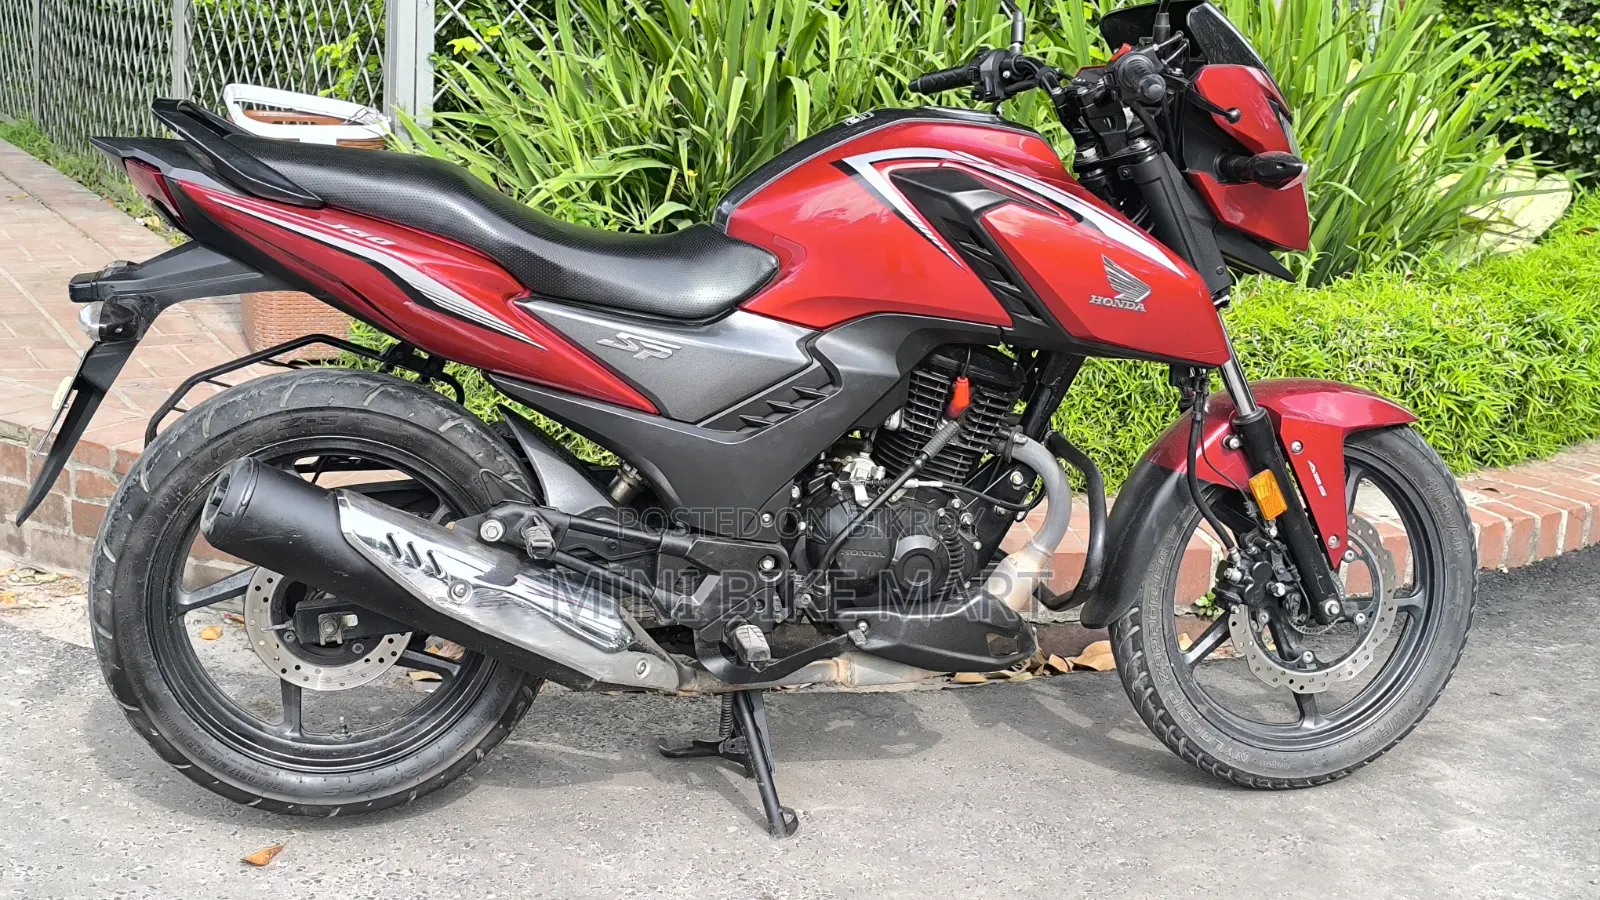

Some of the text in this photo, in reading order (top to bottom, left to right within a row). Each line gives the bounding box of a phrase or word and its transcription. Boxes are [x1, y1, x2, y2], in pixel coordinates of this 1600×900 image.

[330, 224, 397, 246] 160
[1089, 294, 1147, 312] HONDA
[596, 331, 683, 360] SP
[1307, 460, 1327, 497] ABS
[840, 548, 886, 558] HONDA
[1167, 691, 1250, 765] NYLOGRIP
